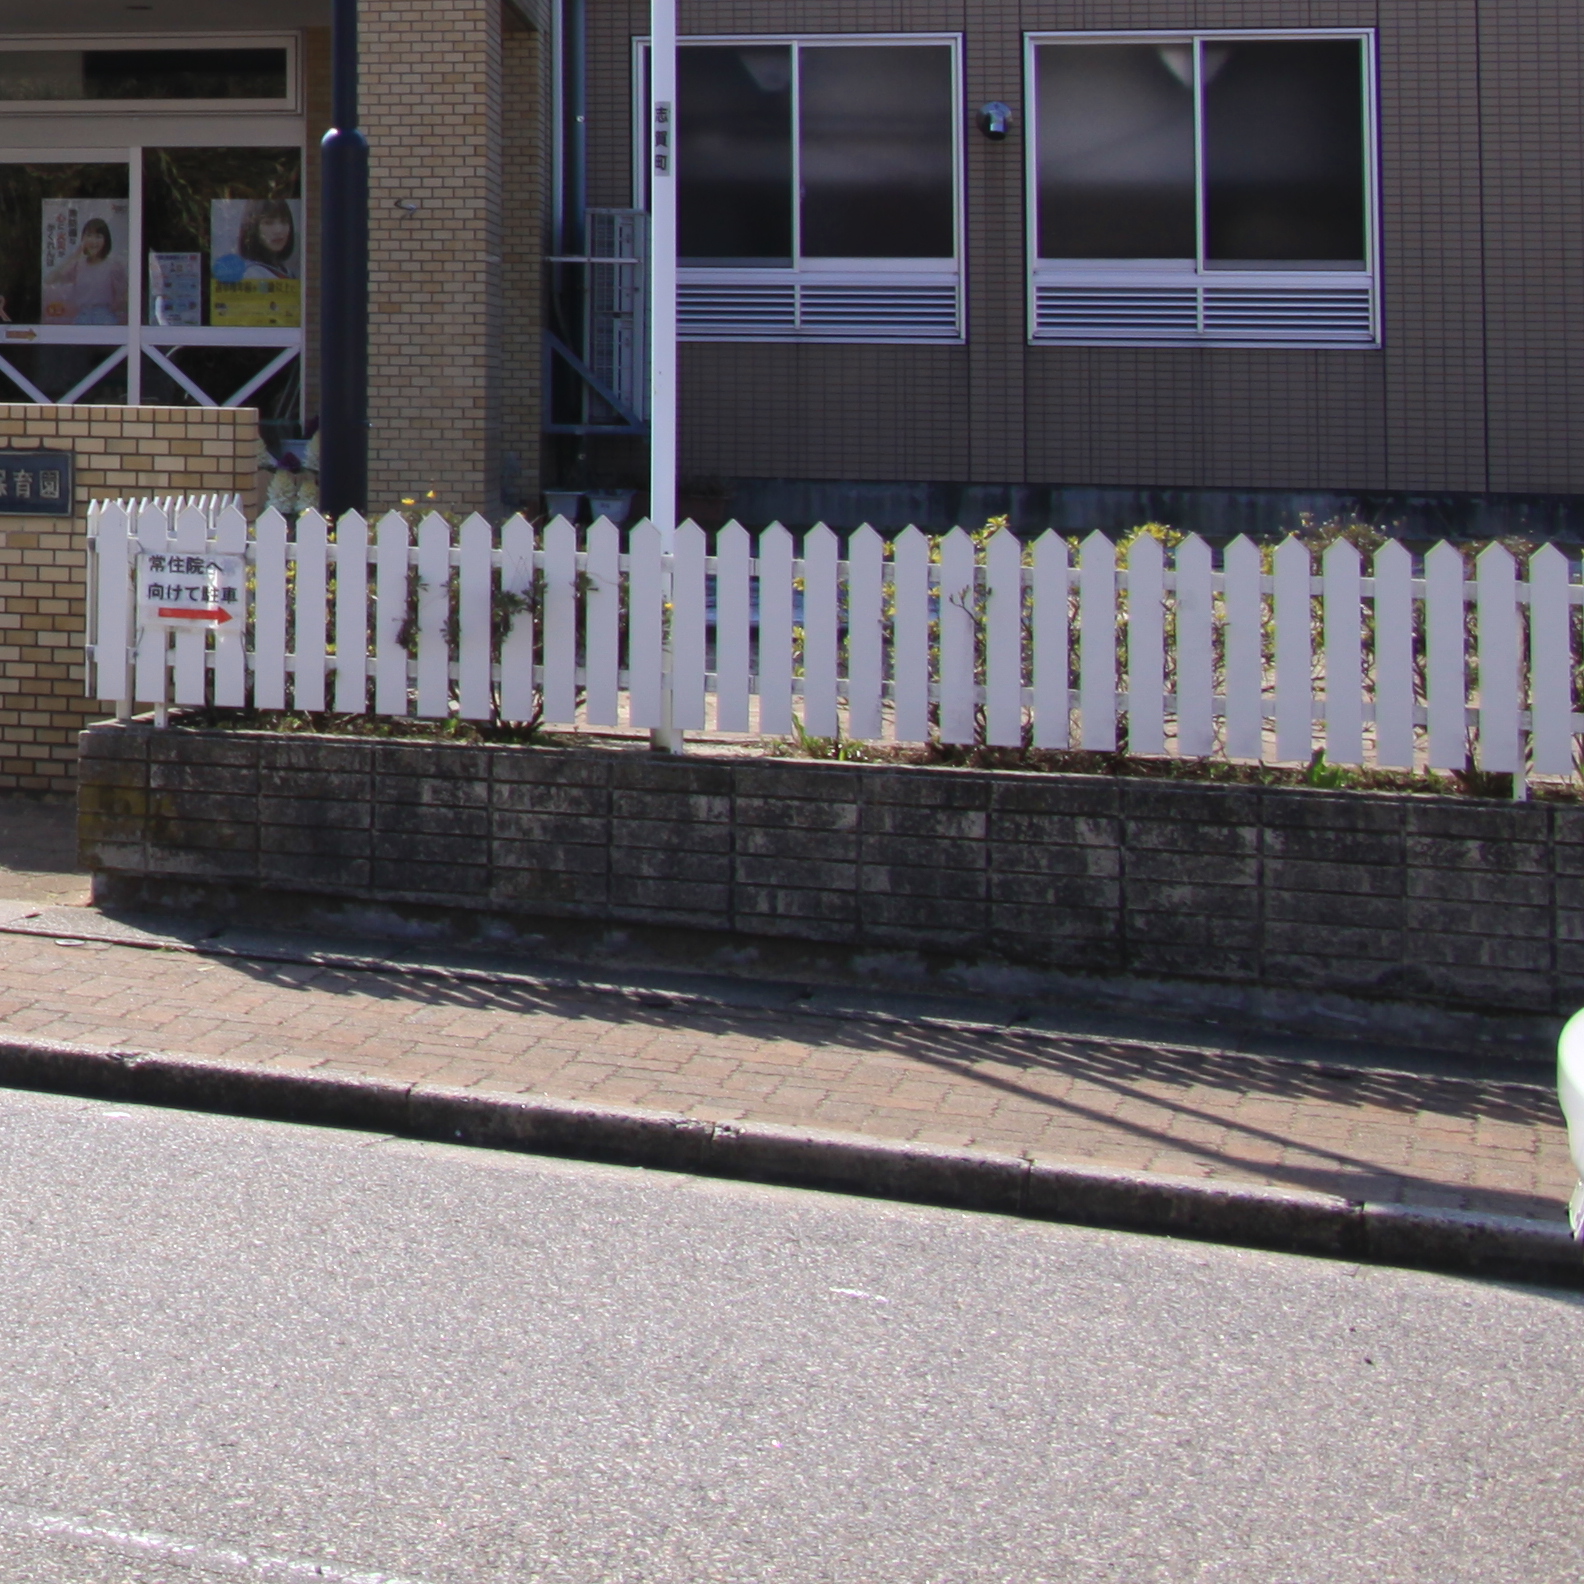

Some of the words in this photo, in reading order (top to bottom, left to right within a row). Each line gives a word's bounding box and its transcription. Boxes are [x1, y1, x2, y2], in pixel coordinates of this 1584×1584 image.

[147, 554, 224, 575] 常住院へ
[147, 582, 238, 604] 向けて駐車
